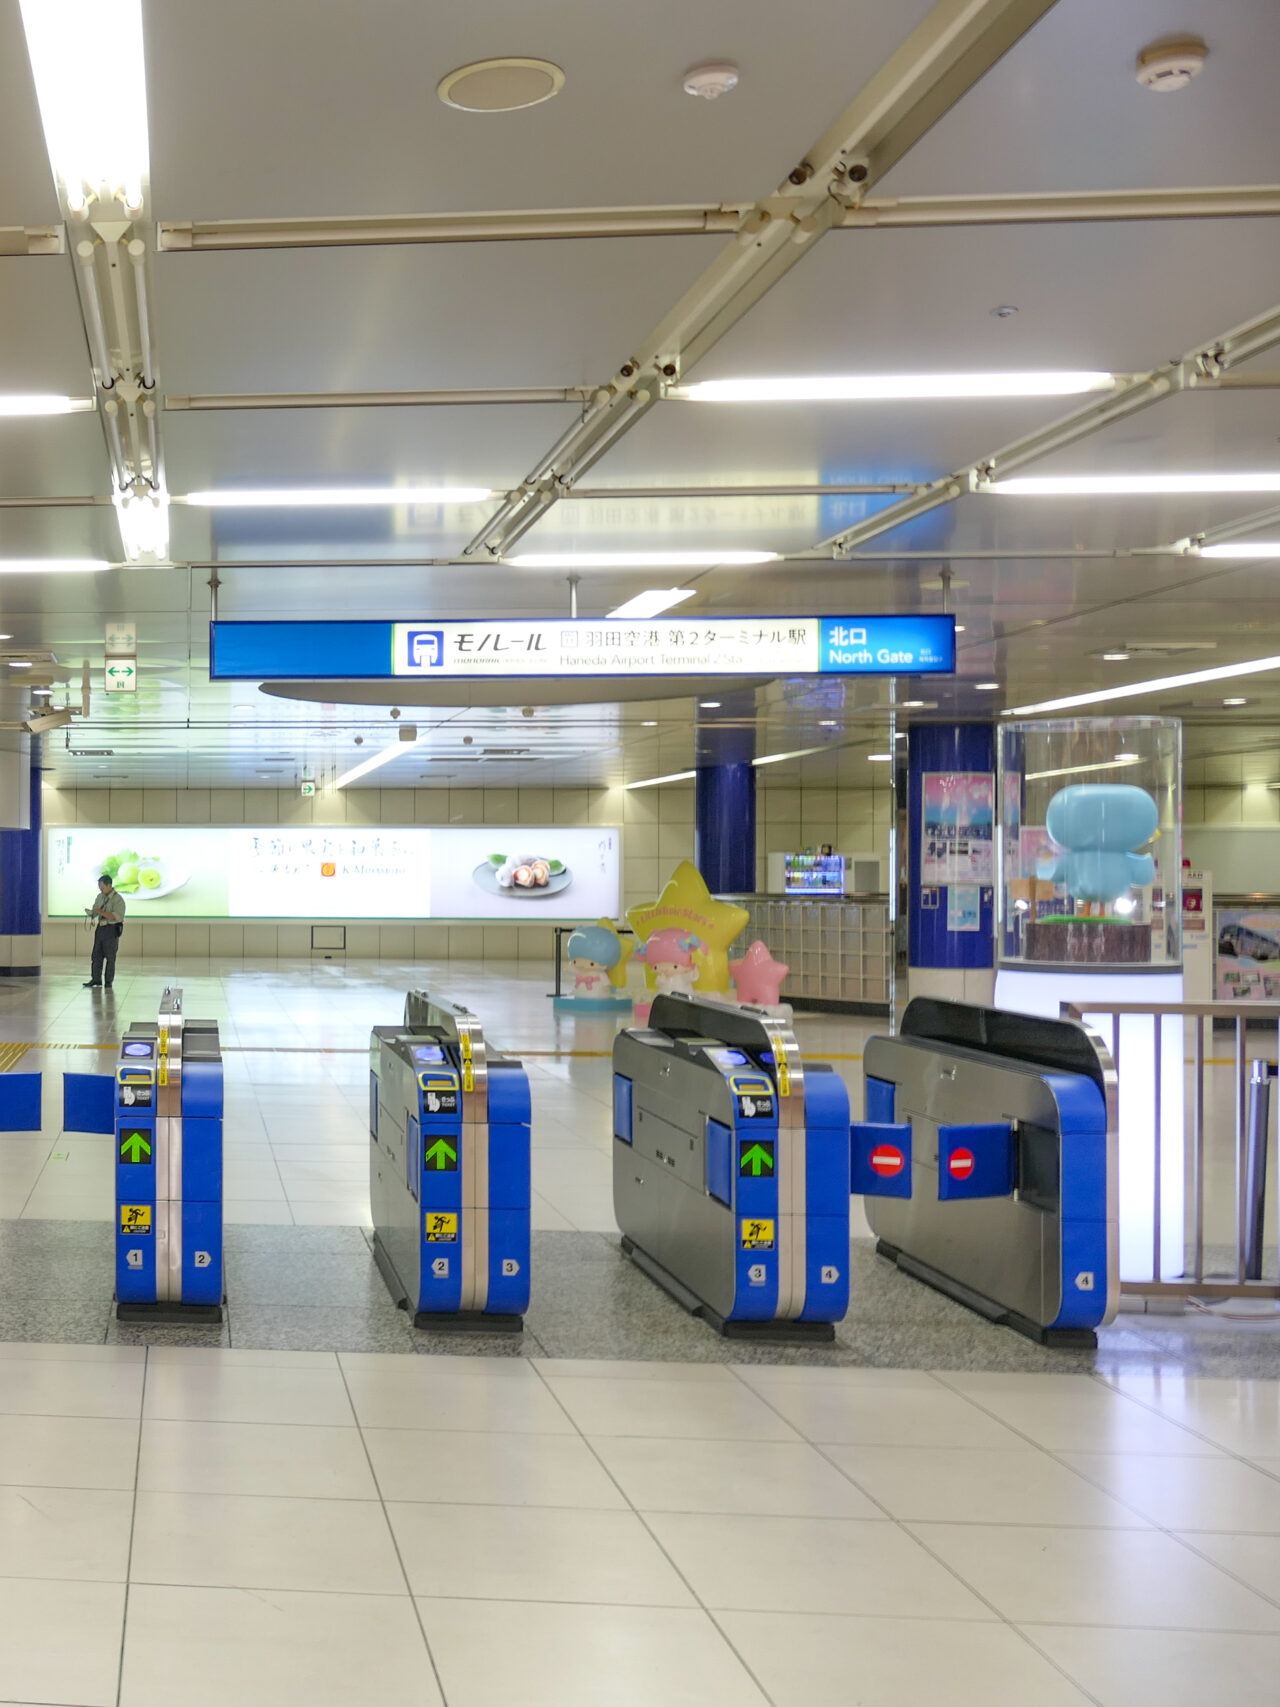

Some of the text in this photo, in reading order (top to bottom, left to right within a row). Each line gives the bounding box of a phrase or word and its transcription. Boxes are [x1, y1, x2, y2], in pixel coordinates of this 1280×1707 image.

[586, 628, 806, 647] 羽田空港 第2ターミナル駅
[829, 626, 867, 646] 北口
[454, 634, 547, 651] モノレール
[560, 655, 607, 666] Haneda
[611, 655, 655, 668] Airport
[660, 654, 710, 665] Terminal
[829, 648, 873, 664] North
[877, 648, 914, 664] Gate
[132, 1253, 138, 1262] 1
[198, 1254, 205, 1264] 2
[438, 1261, 445, 1271] 2
[506, 1262, 514, 1272] 3
[754, 1267, 762, 1277] 3
[824, 1270, 833, 1279] 4
[1081, 1275, 1089, 1285] 4
